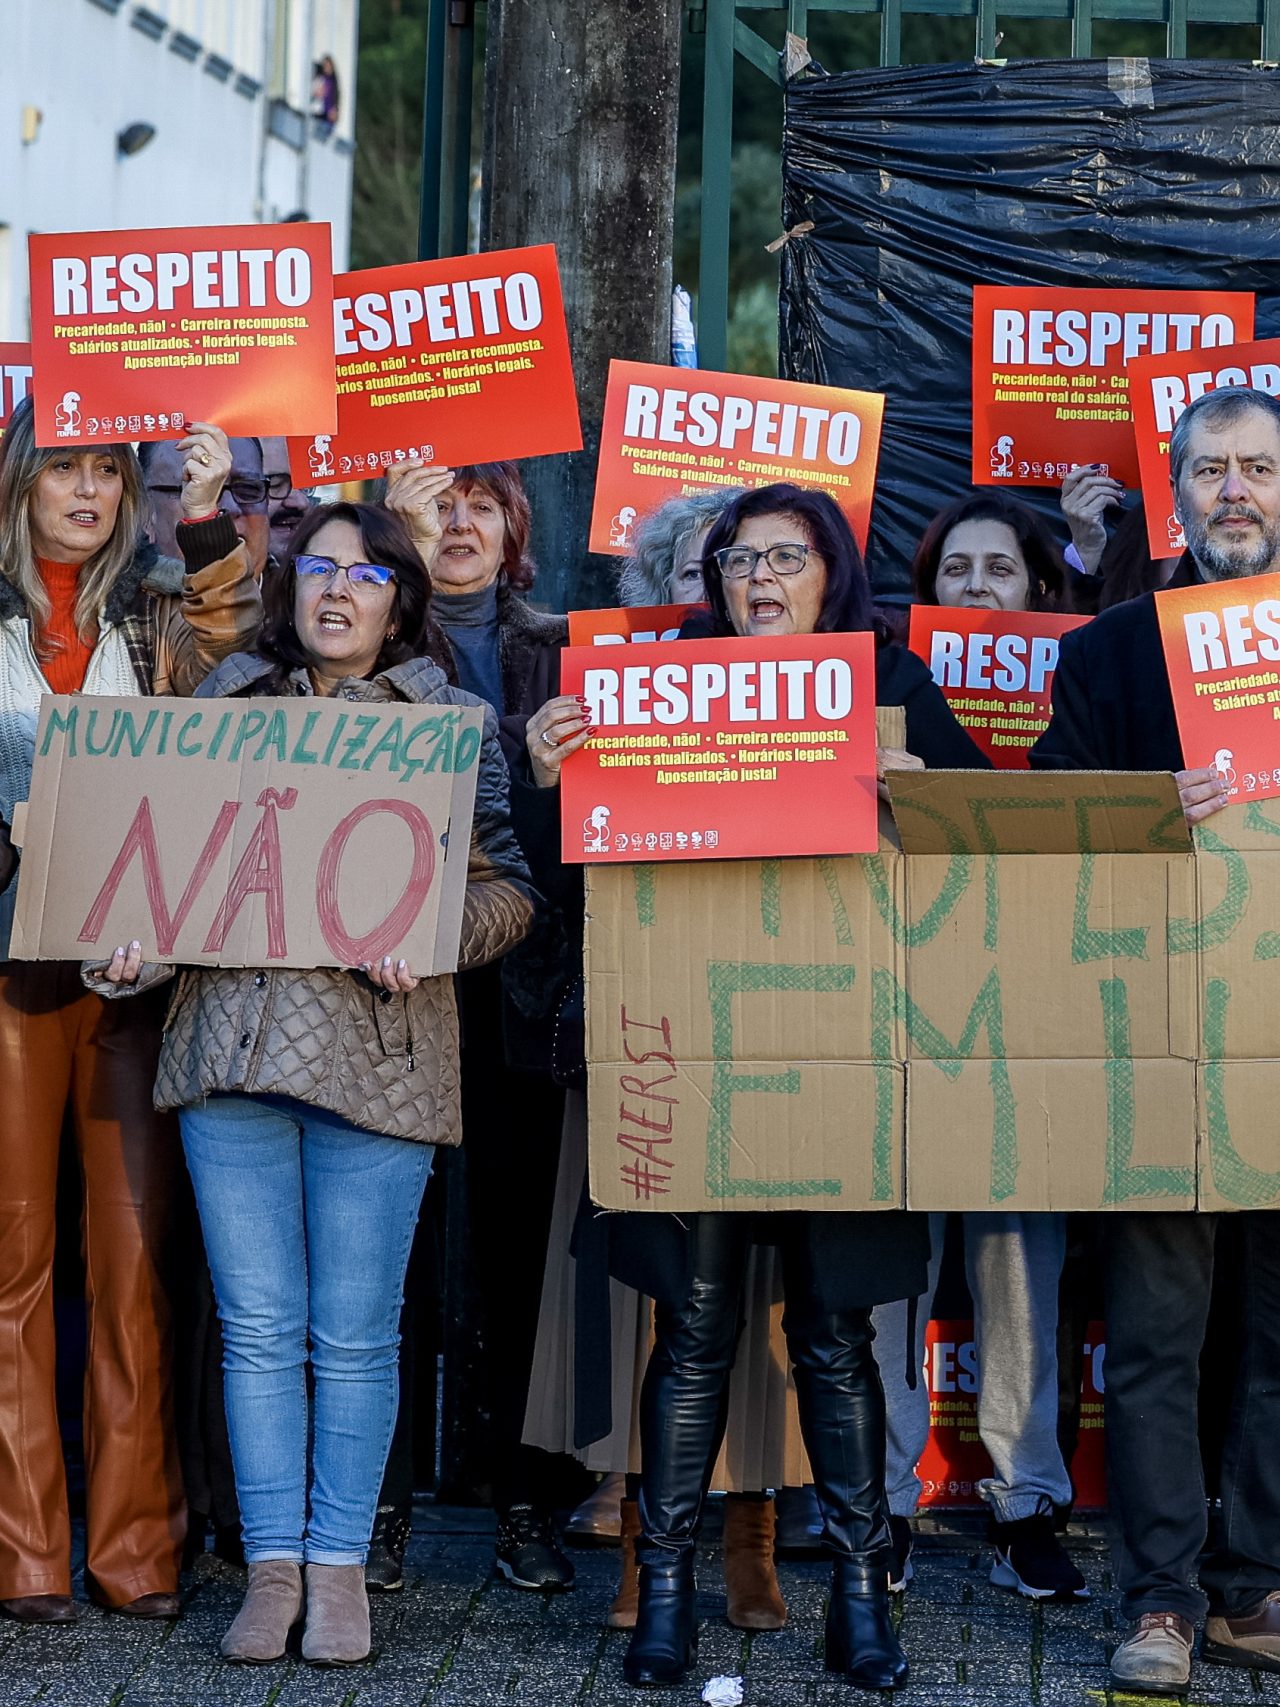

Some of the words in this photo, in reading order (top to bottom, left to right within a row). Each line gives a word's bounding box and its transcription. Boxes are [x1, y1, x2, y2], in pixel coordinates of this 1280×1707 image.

[52, 247, 311, 315] RESPEITO
[53, 321, 137, 338] Precariedade,
[138, 319, 166, 334] não!
[179, 316, 231, 332] Carreira
[232, 315, 309, 330] recomposta.
[333, 272, 543, 355] ESPEITO
[68, 339, 119, 355] Salários
[120, 335, 193, 352] atualizados.
[201, 333, 255, 348] Horários
[255, 332, 298, 348] legais.
[380, 355, 407, 372] não!
[419, 348, 469, 366] Carreira
[470, 340, 545, 359] recomposta.
[123, 351, 202, 370] Aposentação
[203, 350, 240, 366] justa!
[364, 370, 434, 391] atualizados.
[442, 362, 494, 380] Horários
[494, 357, 535, 374] legais.
[992, 372, 1070, 388] Precariedade,
[1071, 374, 1097, 388] não!
[369, 384, 445, 407] Aposentação
[446, 379, 481, 398] justa!
[994, 388, 1044, 403] Aumento
[1046, 391, 1069, 404] real
[1070, 391, 1085, 404] do
[1087, 391, 1130, 405] salário.
[624, 384, 861, 466] RESPEITO
[1055, 407, 1130, 423] Aposentação
[620, 444, 698, 466] Precariedade,
[699, 454, 725, 469] não!
[737, 458, 783, 477] Carreira
[784, 467, 852, 487] recomposta.
[632, 461, 679, 479] Salários
[679, 469, 746, 487] atualizados.
[929, 630, 1060, 693] RESP
[583, 659, 852, 727] RESPEITO
[1008, 699, 1036, 714] não!
[1212, 692, 1266, 712] Salários
[989, 716, 1049, 732] atualizado
[39, 708, 481, 783] MUNICIPALIZAÇÃO
[672, 732, 701, 747] não!
[715, 730, 769, 745] Carreira
[770, 730, 850, 745] recomposta.
[598, 752, 651, 768] Salários
[652, 749, 728, 766] atualizados.
[737, 747, 793, 763] Horários
[794, 747, 838, 763] legais.
[656, 766, 738, 784] Aposentação
[739, 766, 777, 782] justa!
[77, 786, 436, 967] NÃO
[704, 959, 1021, 1203] EM
[616, 1003, 680, 1201] #AERSI
